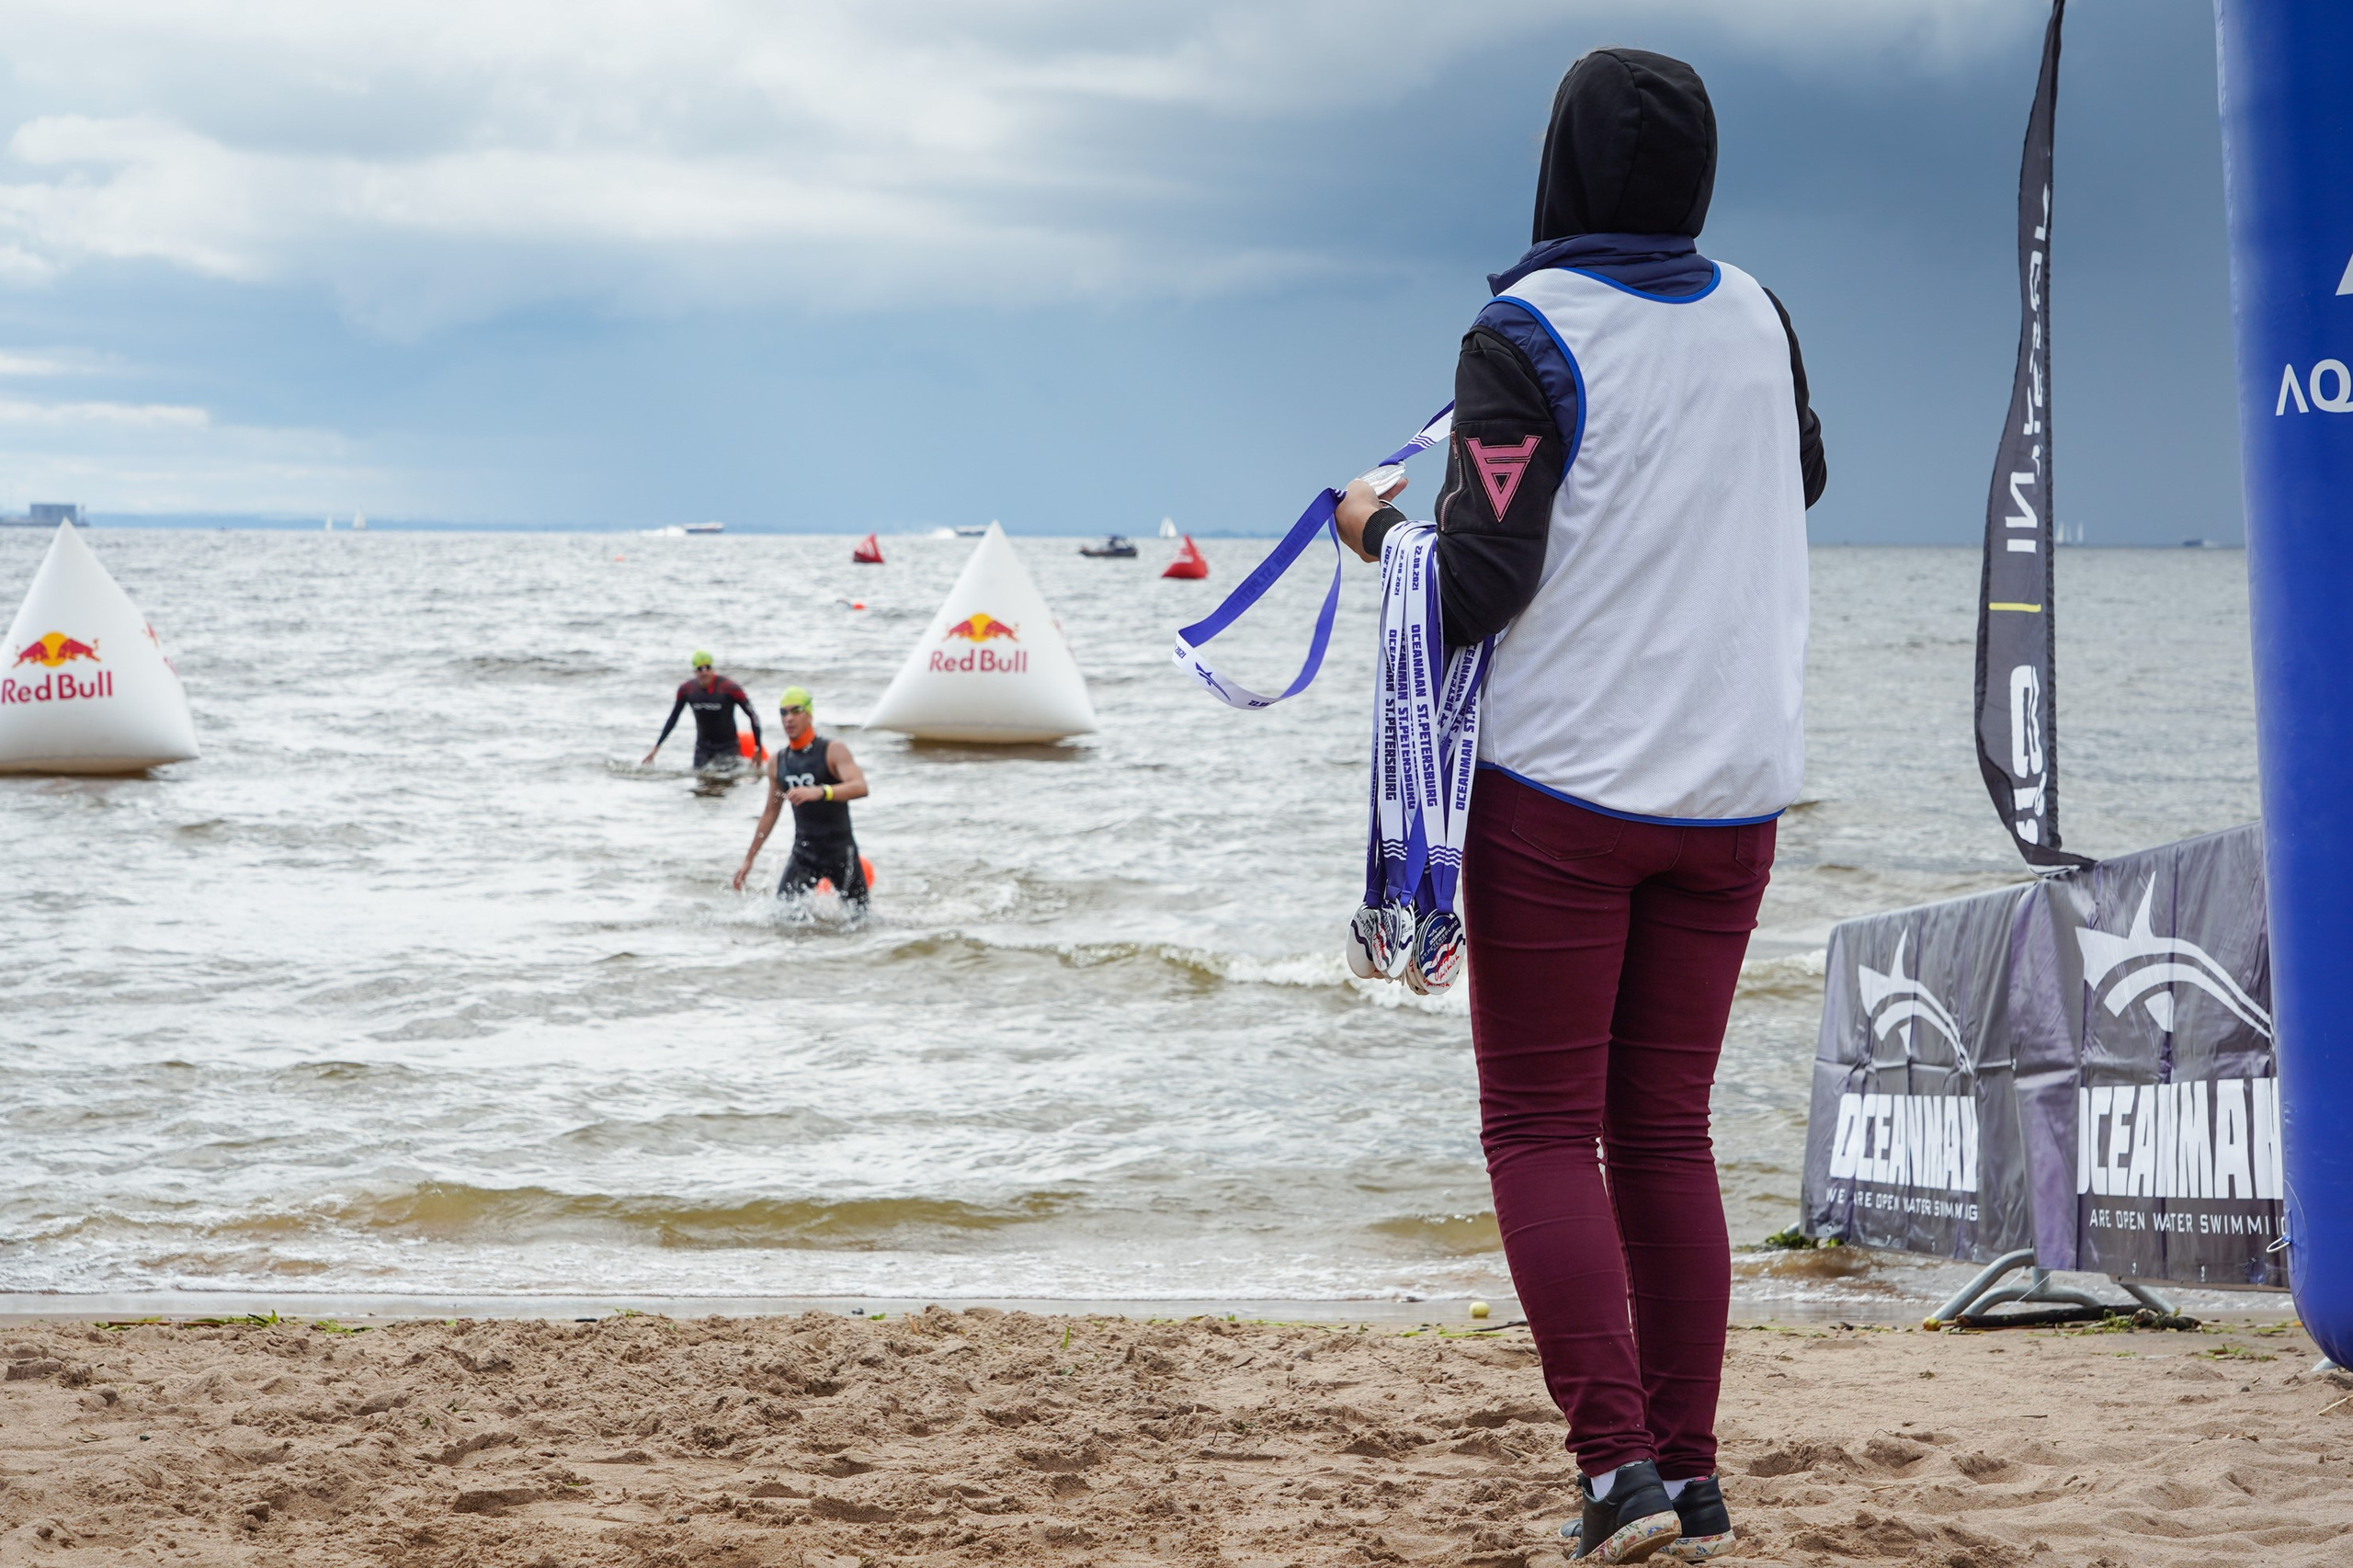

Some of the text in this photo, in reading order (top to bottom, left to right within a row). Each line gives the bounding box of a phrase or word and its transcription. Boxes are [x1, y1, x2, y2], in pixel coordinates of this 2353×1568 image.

[1412, 545, 1423, 591] 22.08.2021
[1, 670, 113, 704] Red Bull
[929, 649, 1028, 673] Red Bull
[1411, 624, 1427, 698] OCEANMAN
[1385, 699, 1397, 801] ST.PETERSBURG
[1416, 704, 1438, 807] ST.PETERSBURG
[1455, 739, 1473, 811] OCEANMAN
[1829, 1092, 1979, 1193] OCEANMAN
[1825, 1187, 1846, 1205] WE
[1875, 1193, 1900, 1211] OPEN
[2089, 1209, 2111, 1228] ARE
[2117, 1210, 2145, 1231] OPEN
[2154, 1212, 2193, 1233] WATER
